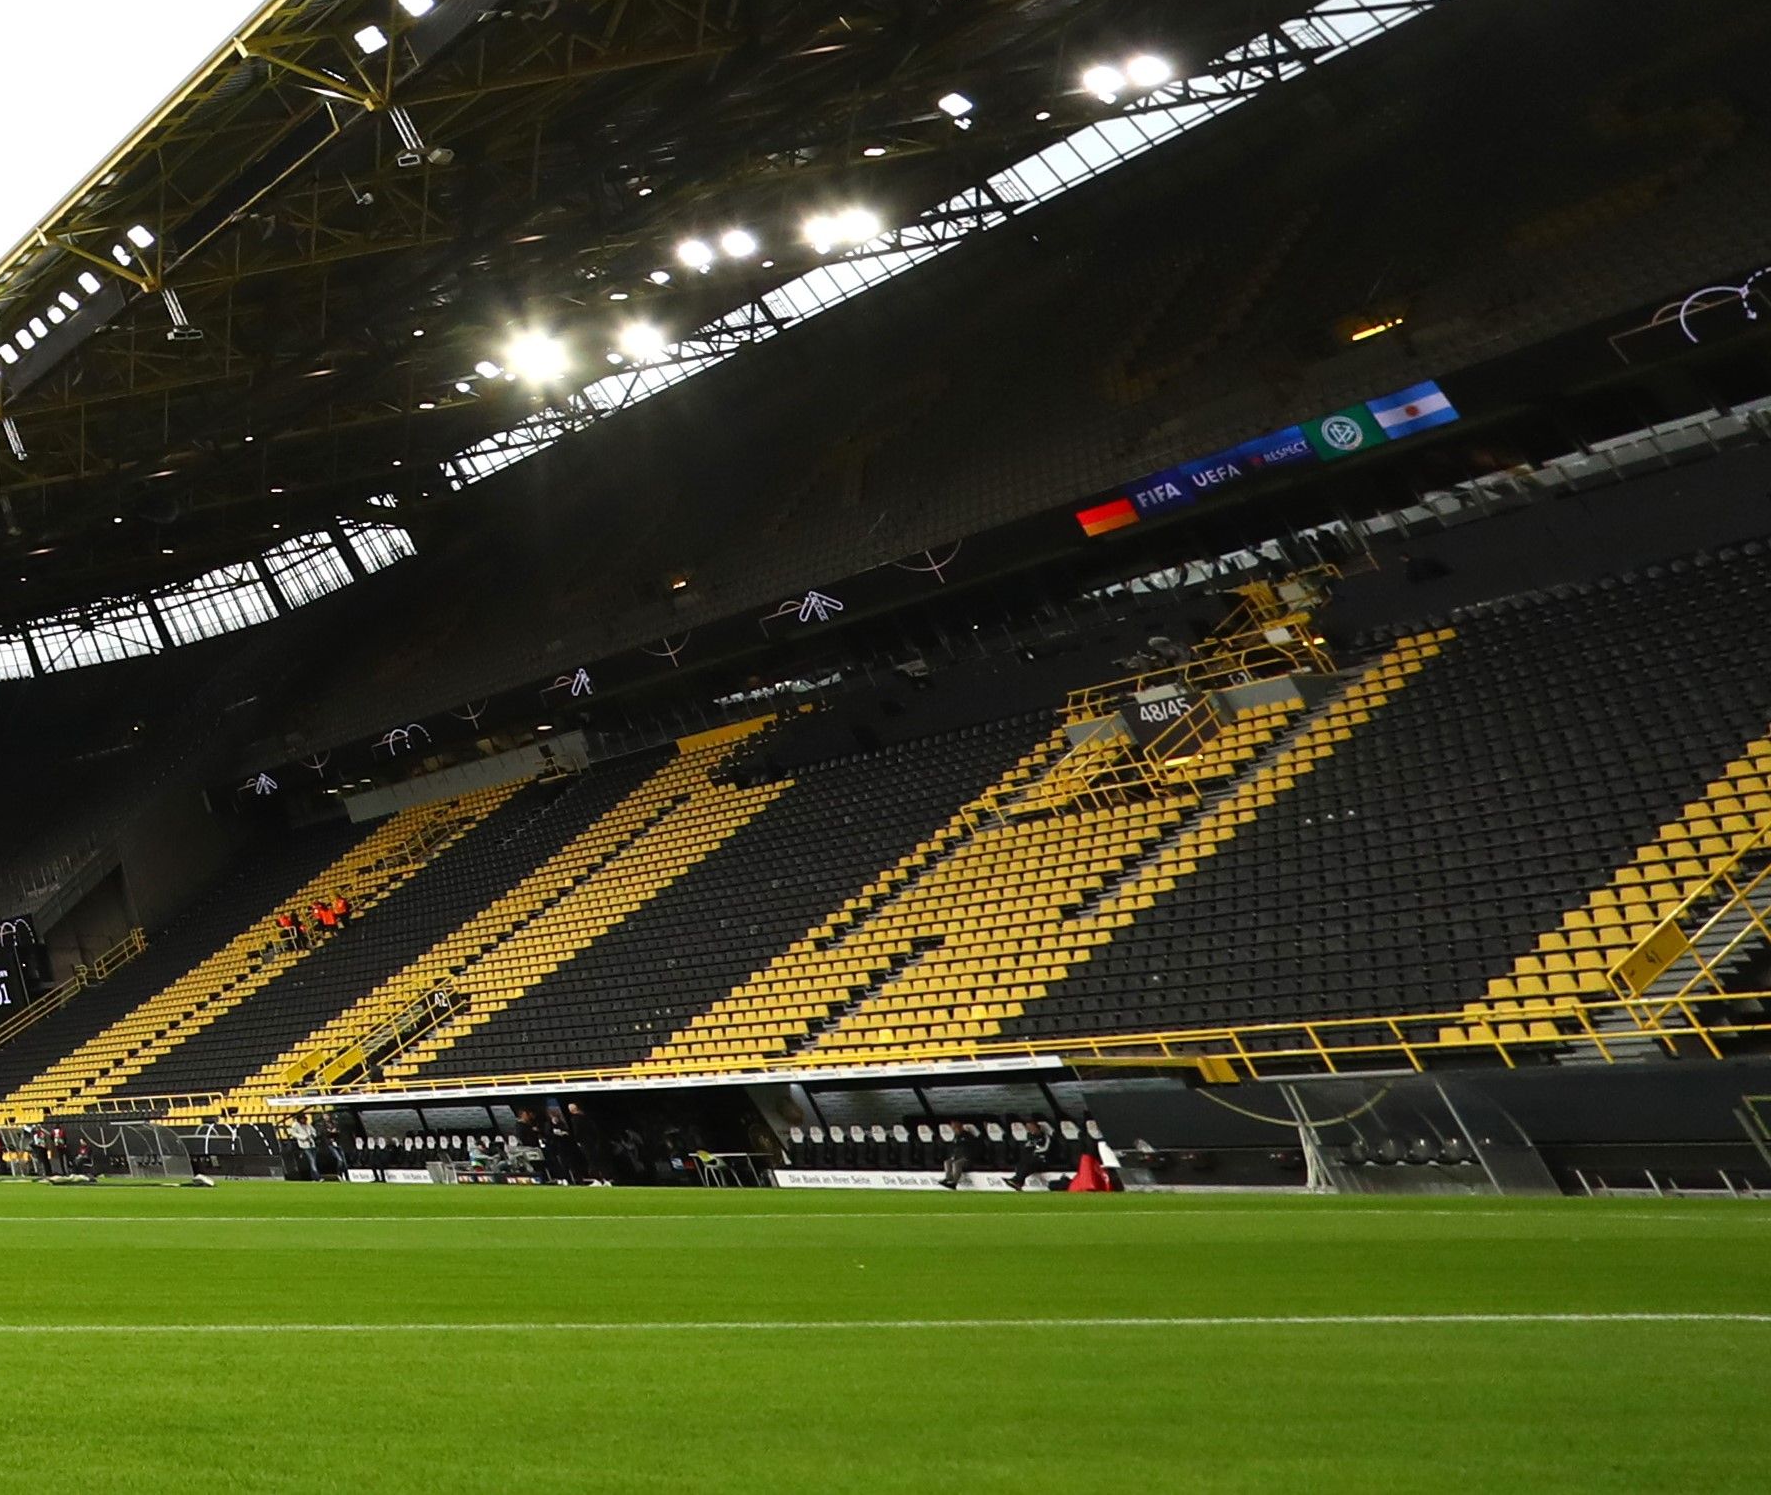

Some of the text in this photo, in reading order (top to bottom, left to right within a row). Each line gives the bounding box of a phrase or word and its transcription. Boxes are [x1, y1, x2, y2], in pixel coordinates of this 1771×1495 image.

[1262, 439, 1309, 464] RESPECT
[1192, 463, 1242, 489] UEFA
[1136, 481, 1183, 508] FIFA
[1140, 697, 1192, 723] 48/45
